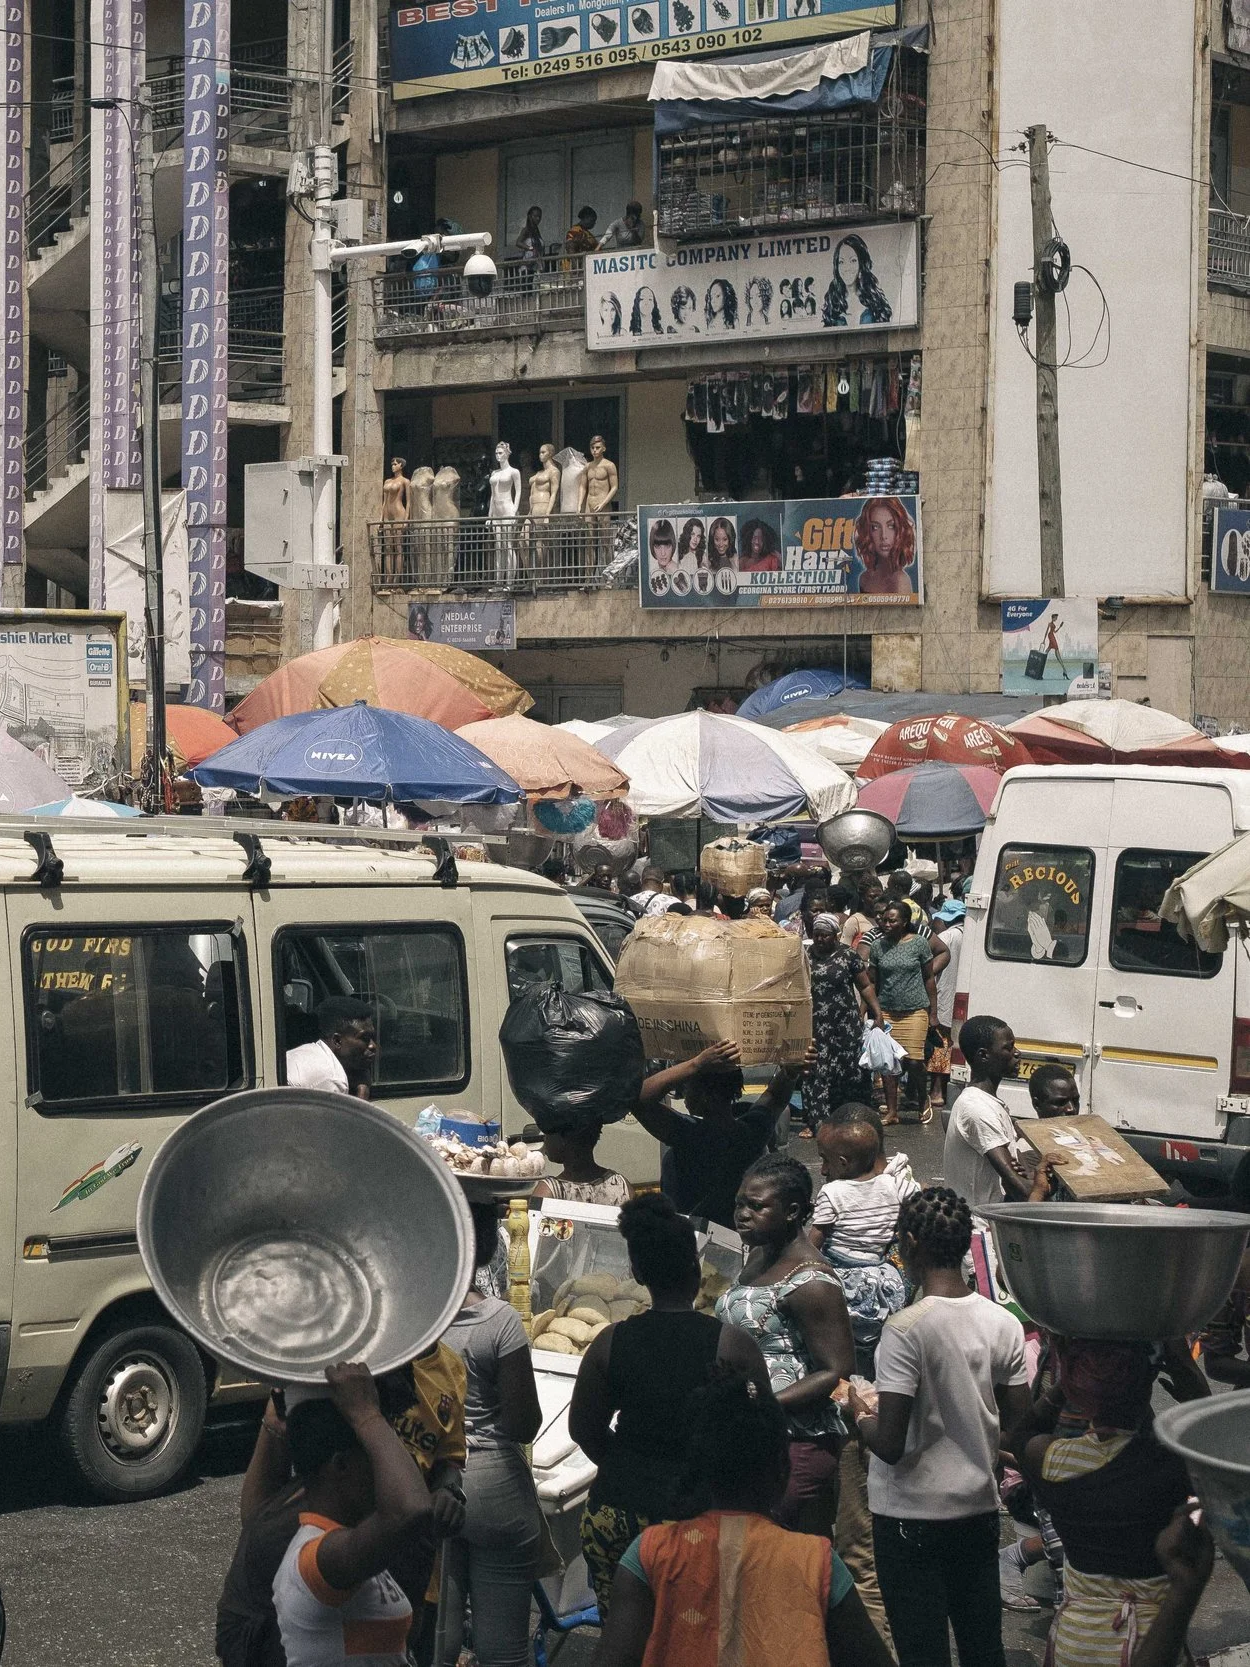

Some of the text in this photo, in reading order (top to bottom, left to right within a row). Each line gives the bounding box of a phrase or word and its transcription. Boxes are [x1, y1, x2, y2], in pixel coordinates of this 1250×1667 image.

[534, 6, 565, 18] Dealers
[502, 67, 528, 80] Tel:
[533, 58, 570, 76] 0249
[576, 53, 603, 70] 516
[608, 48, 637, 64] 095
[651, 39, 691, 57] 0543
[696, 34, 726, 50] 090
[732, 28, 762, 44] 102
[666, 243, 751, 268] COMPANY
[757, 235, 831, 258] LIMTED
[802, 517, 854, 551] Gift
[750, 570, 837, 585] KOLLECTION
[738, 586, 772, 595] GEORGINA
[773, 586, 797, 594] STORE
[798, 585, 821, 594] (FIRST
[440, 624, 482, 633] ENTERPRISE
[29, 632, 72, 644] Market
[784, 689, 809, 700] NIVEA
[310, 751, 356, 761] NIVEA
[32, 938, 74, 952] GOD
[40, 972, 95, 991] THEW
[653, 1018, 663, 1031] IN
[666, 1020, 701, 1033] CHINA
